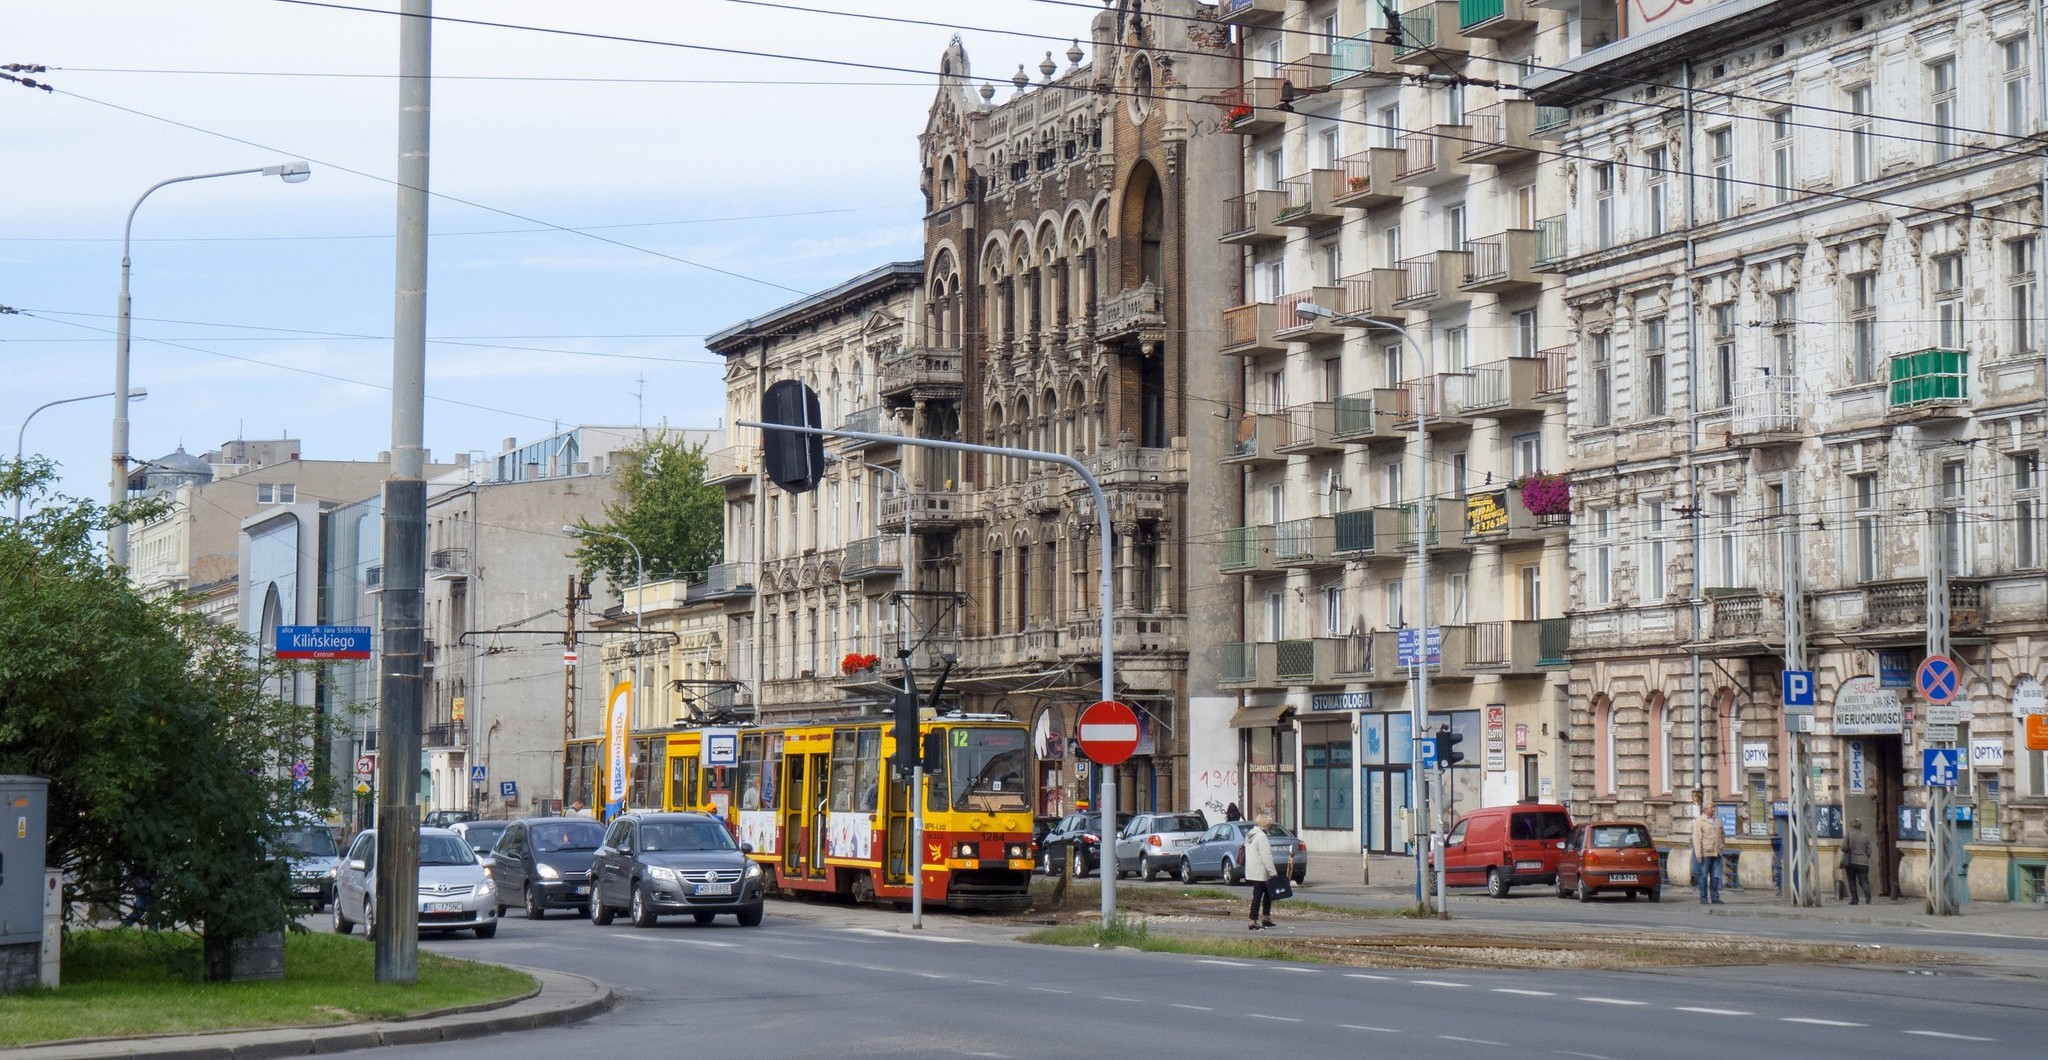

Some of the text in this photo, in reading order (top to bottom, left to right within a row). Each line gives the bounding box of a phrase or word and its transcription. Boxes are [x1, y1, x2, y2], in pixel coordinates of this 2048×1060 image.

[293, 634, 355, 651] Kilińskiego
[1790, 674, 1808, 702] P
[1314, 693, 1371, 710] STOMATOLOGIA
[953, 731, 968, 747] 12
[614, 717, 623, 794] naszemiasto
[1744, 749, 1767, 761] OPTYK
[1974, 746, 2003, 760] OPTYK
[1852, 742, 1862, 789] OPTYK
[982, 832, 1005, 841] 1284
